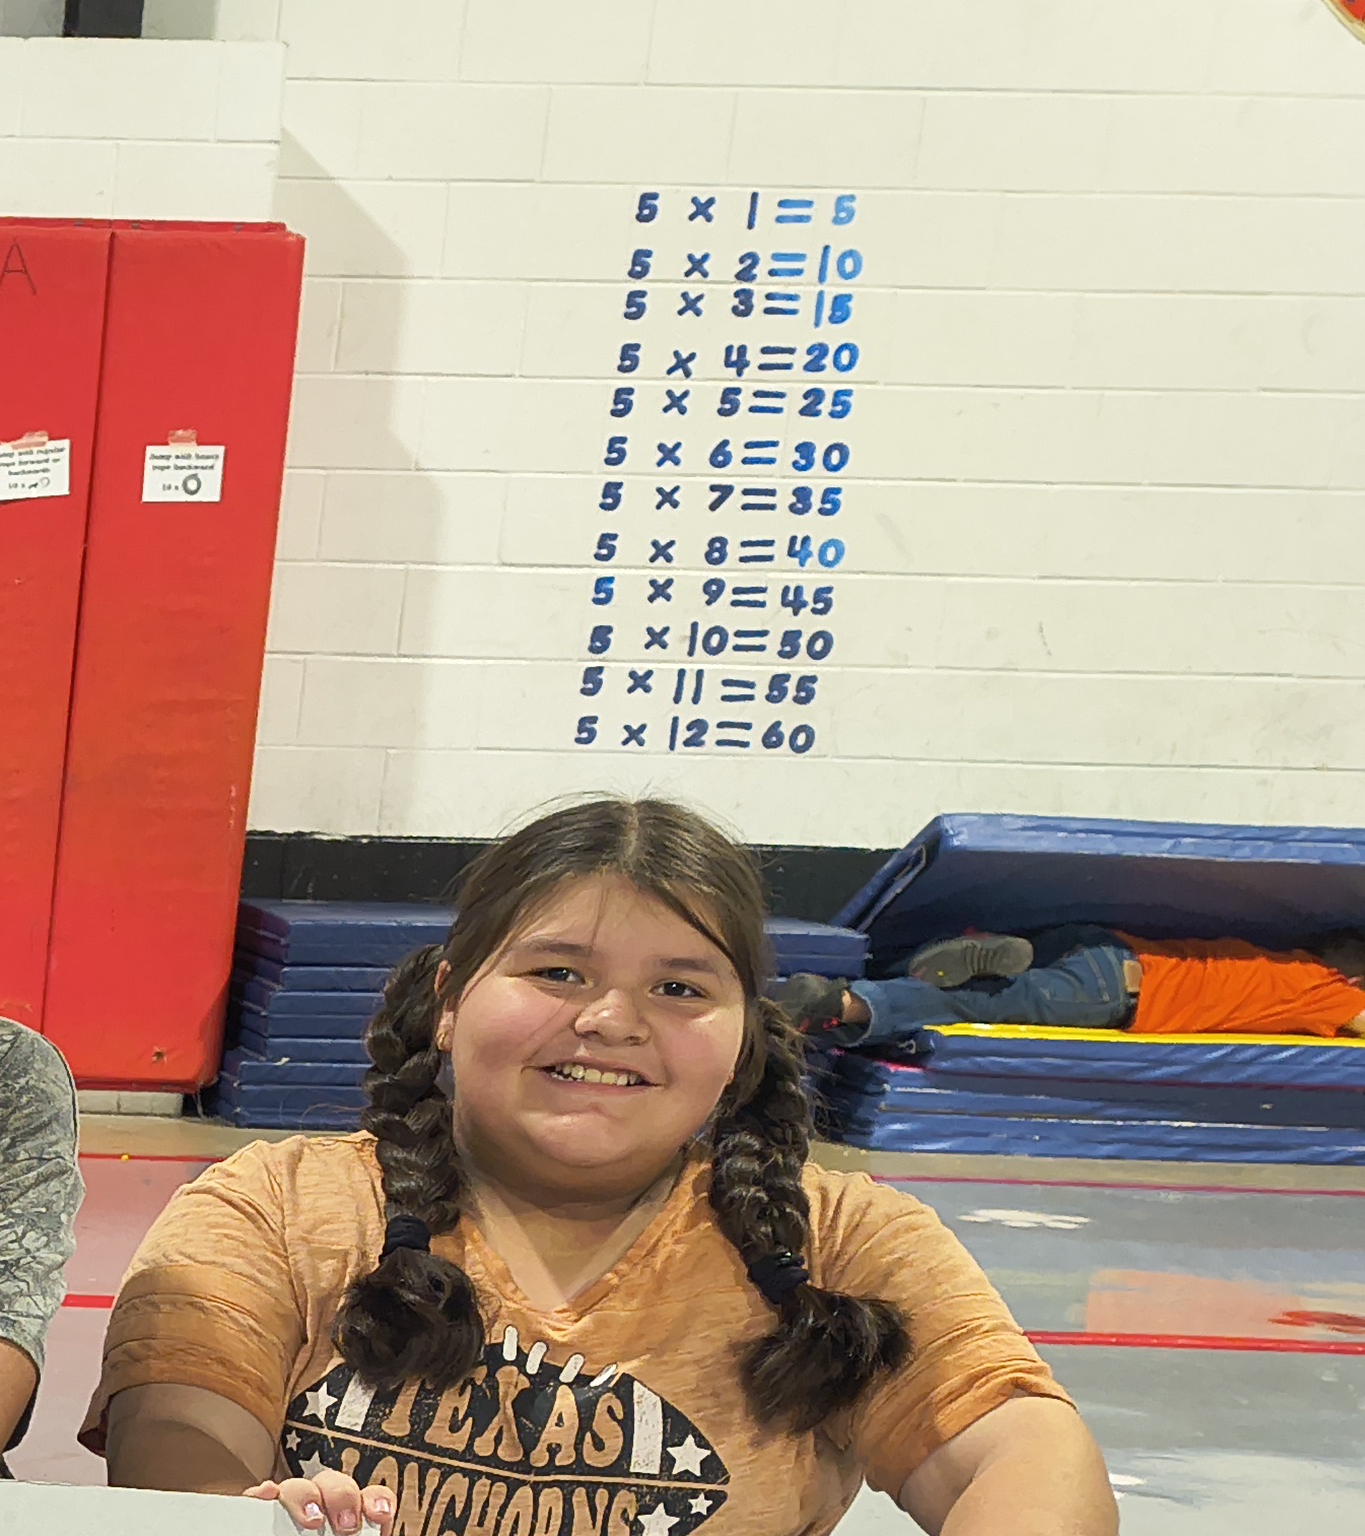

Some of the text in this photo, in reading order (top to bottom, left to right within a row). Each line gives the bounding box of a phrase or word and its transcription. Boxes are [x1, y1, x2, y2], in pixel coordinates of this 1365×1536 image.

[635, 192, 660, 223] 5
[746, 191, 759, 230] 1
[832, 194, 856, 226] 5
[627, 248, 654, 280] 5
[734, 251, 760, 283] 2
[817, 244, 862, 284] 10
[623, 288, 853, 328] 5 3 15
[616, 342, 859, 378] 5 4 20
[609, 386, 854, 419] 5 5 25
[603, 436, 850, 473] 5 6 30
[598, 481, 843, 517] 5 7 35
[593, 532, 845, 569] 5 8 40
[591, 576, 834, 617] 5 9 45
[587, 621, 834, 661] 5 10 50
[579, 665, 819, 706] 5 11 55
[574, 715, 816, 754] 5 12 60
